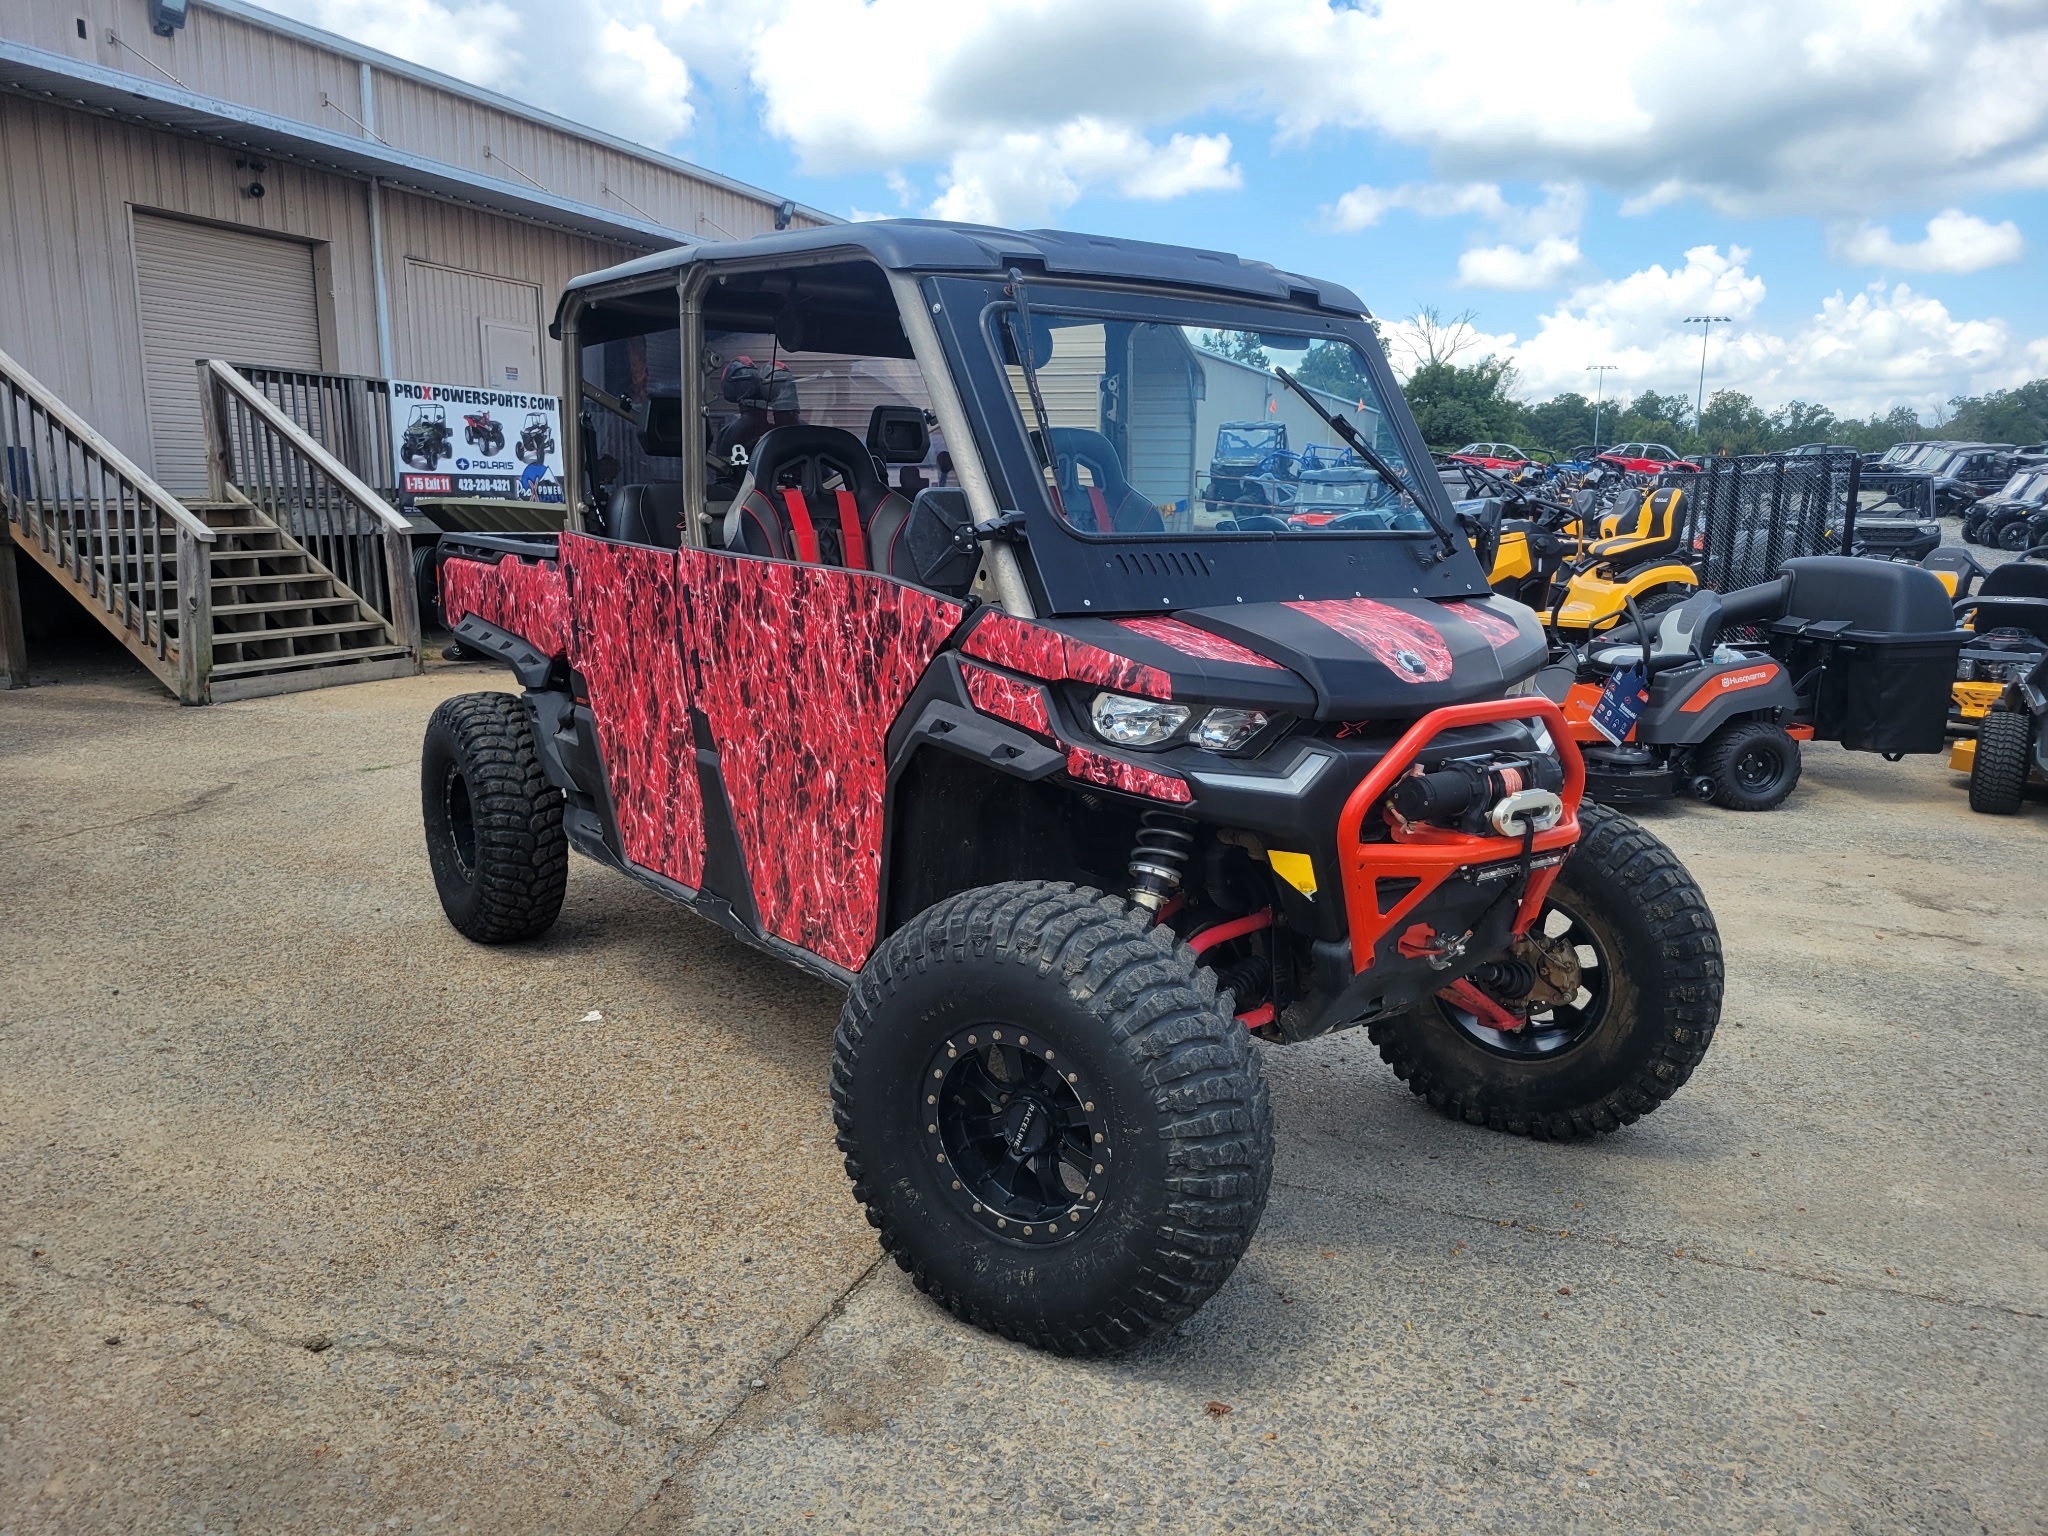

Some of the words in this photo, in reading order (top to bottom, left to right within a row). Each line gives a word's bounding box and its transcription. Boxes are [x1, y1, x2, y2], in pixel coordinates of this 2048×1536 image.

[394, 383, 555, 411] PROXPOWERSPORTS.COM
[472, 460, 514, 470] POLARIS
[406, 477, 423, 490] I-75
[425, 477, 440, 490] Exit
[441, 478, 450, 491] 11
[1730, 671, 1766, 685] Husqvarna
[1012, 1103, 1035, 1149] RACELINE
